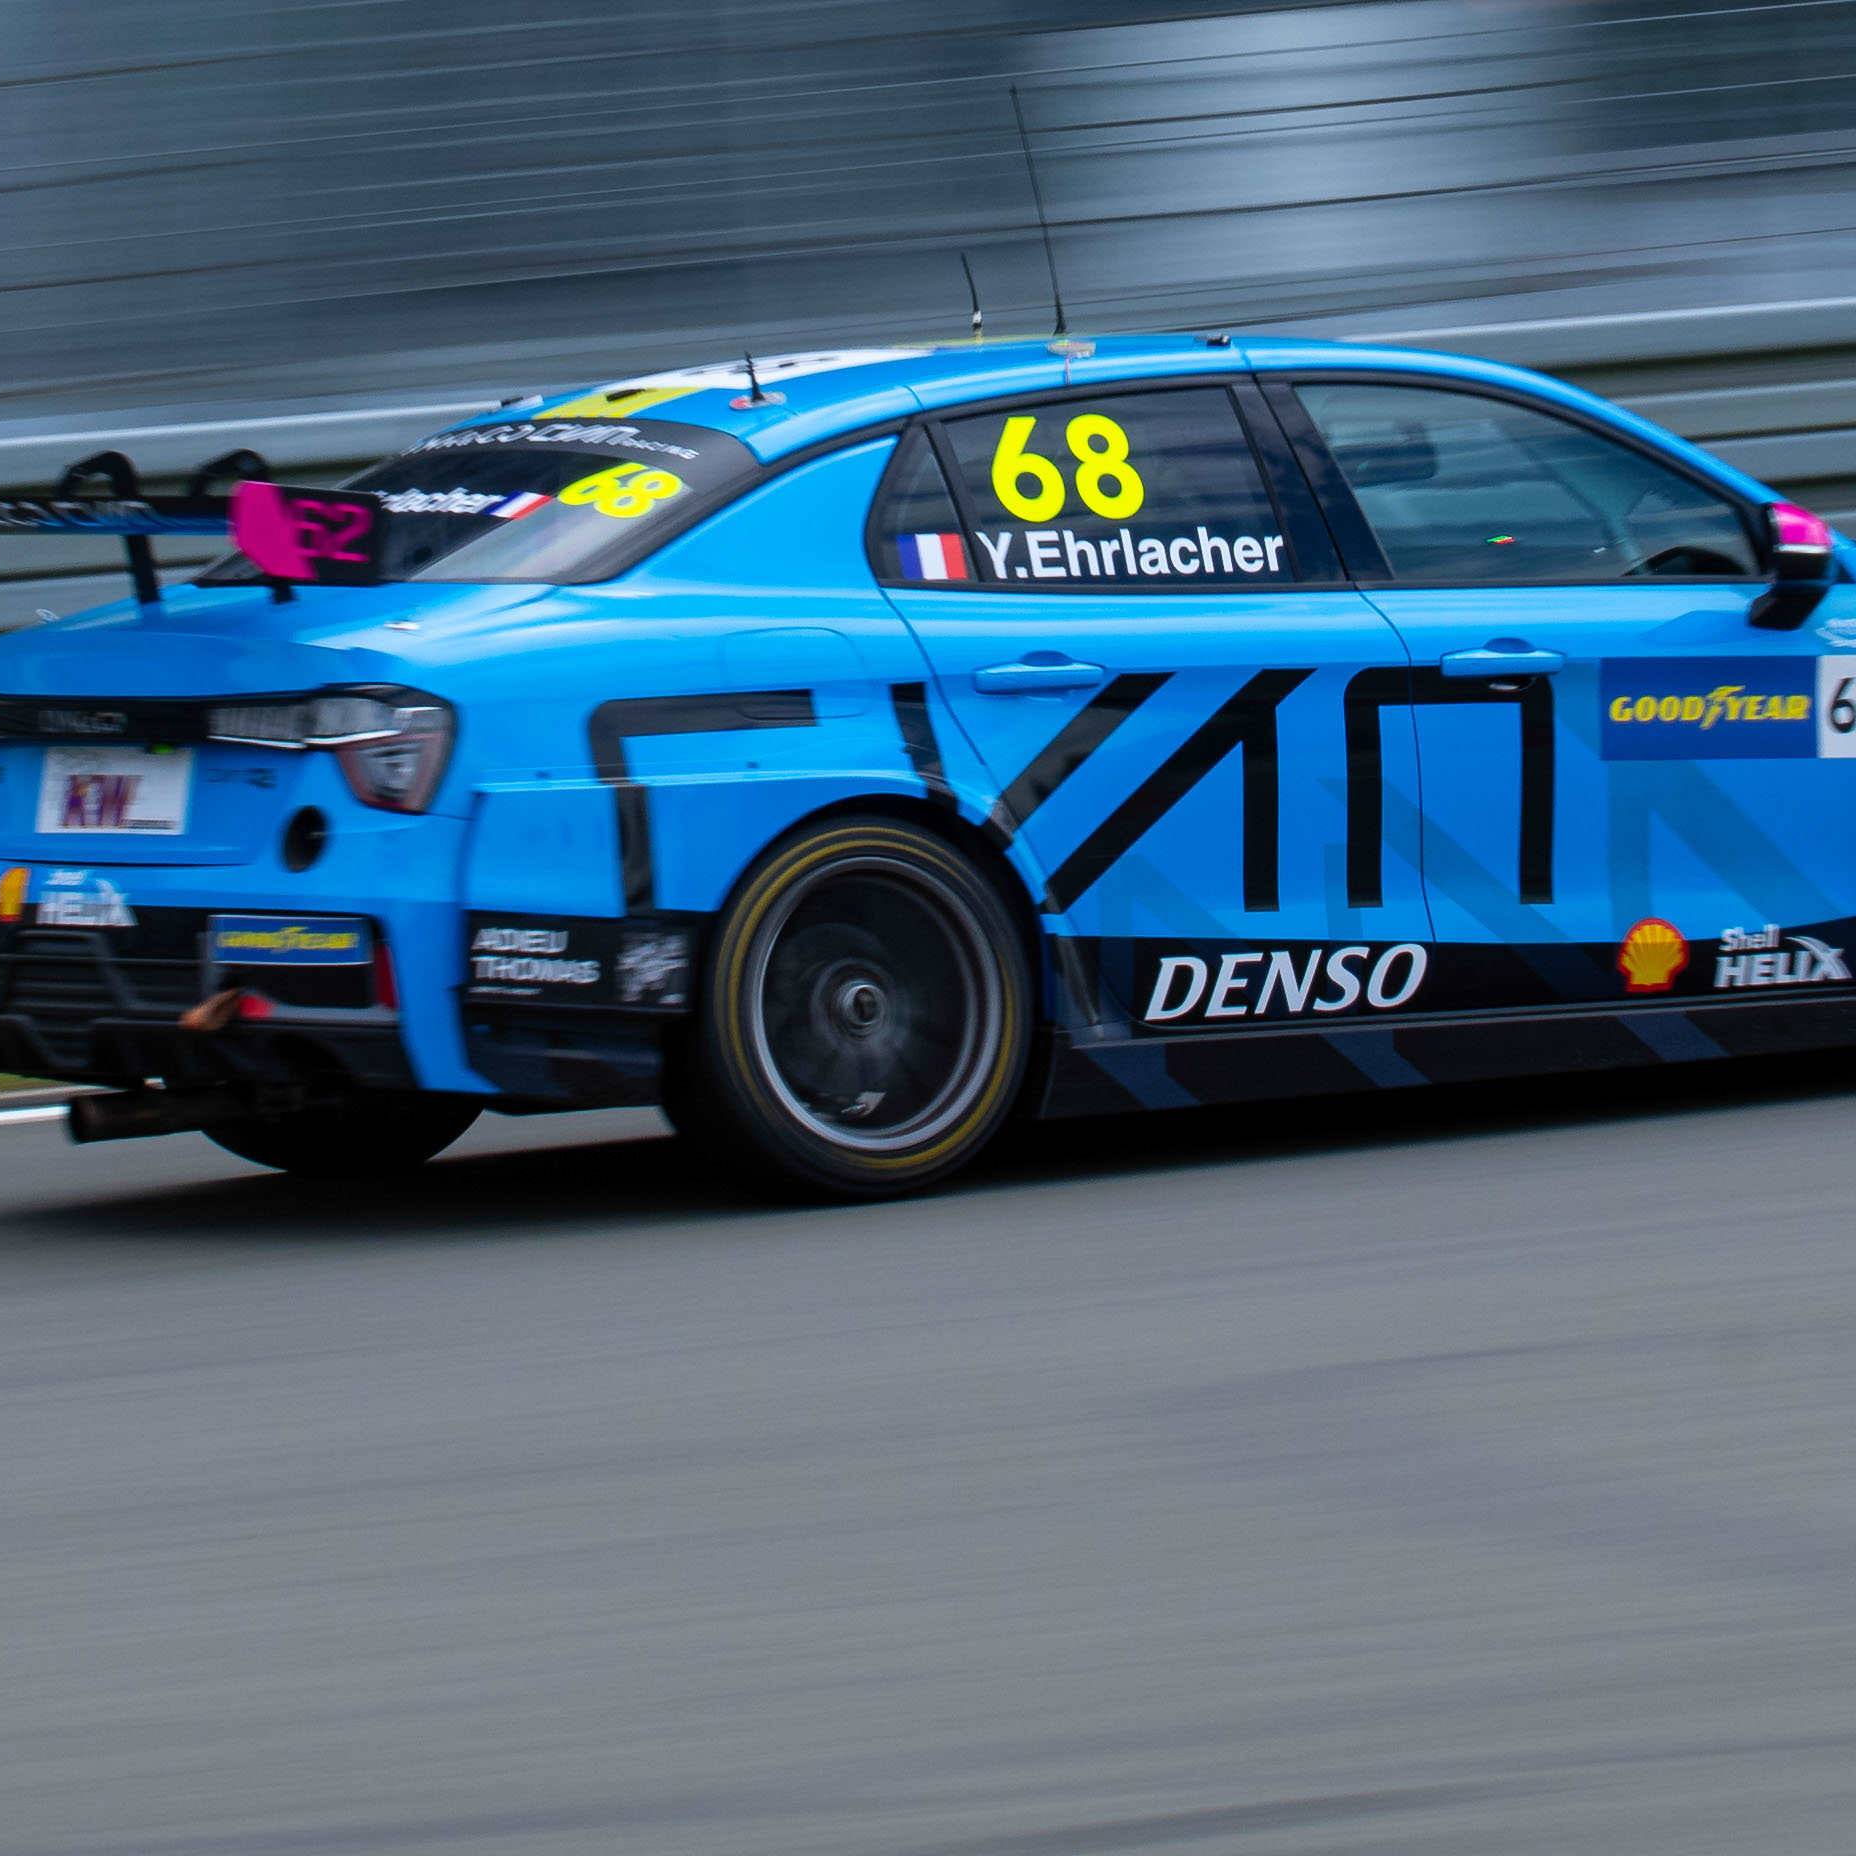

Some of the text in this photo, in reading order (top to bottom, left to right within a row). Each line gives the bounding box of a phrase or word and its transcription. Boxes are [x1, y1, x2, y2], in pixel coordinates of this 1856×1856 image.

[557, 462, 683, 518] 68
[991, 413, 1144, 522] 68
[975, 526, 1284, 579] Y.Ehrlacher
[1609, 685, 1812, 730] GOODYEAR
[1713, 936, 1853, 988] HELIX
[1719, 923, 1781, 951] Shell
[471, 955, 602, 984] THOMAS
[1144, 943, 1428, 1021] DENSO
